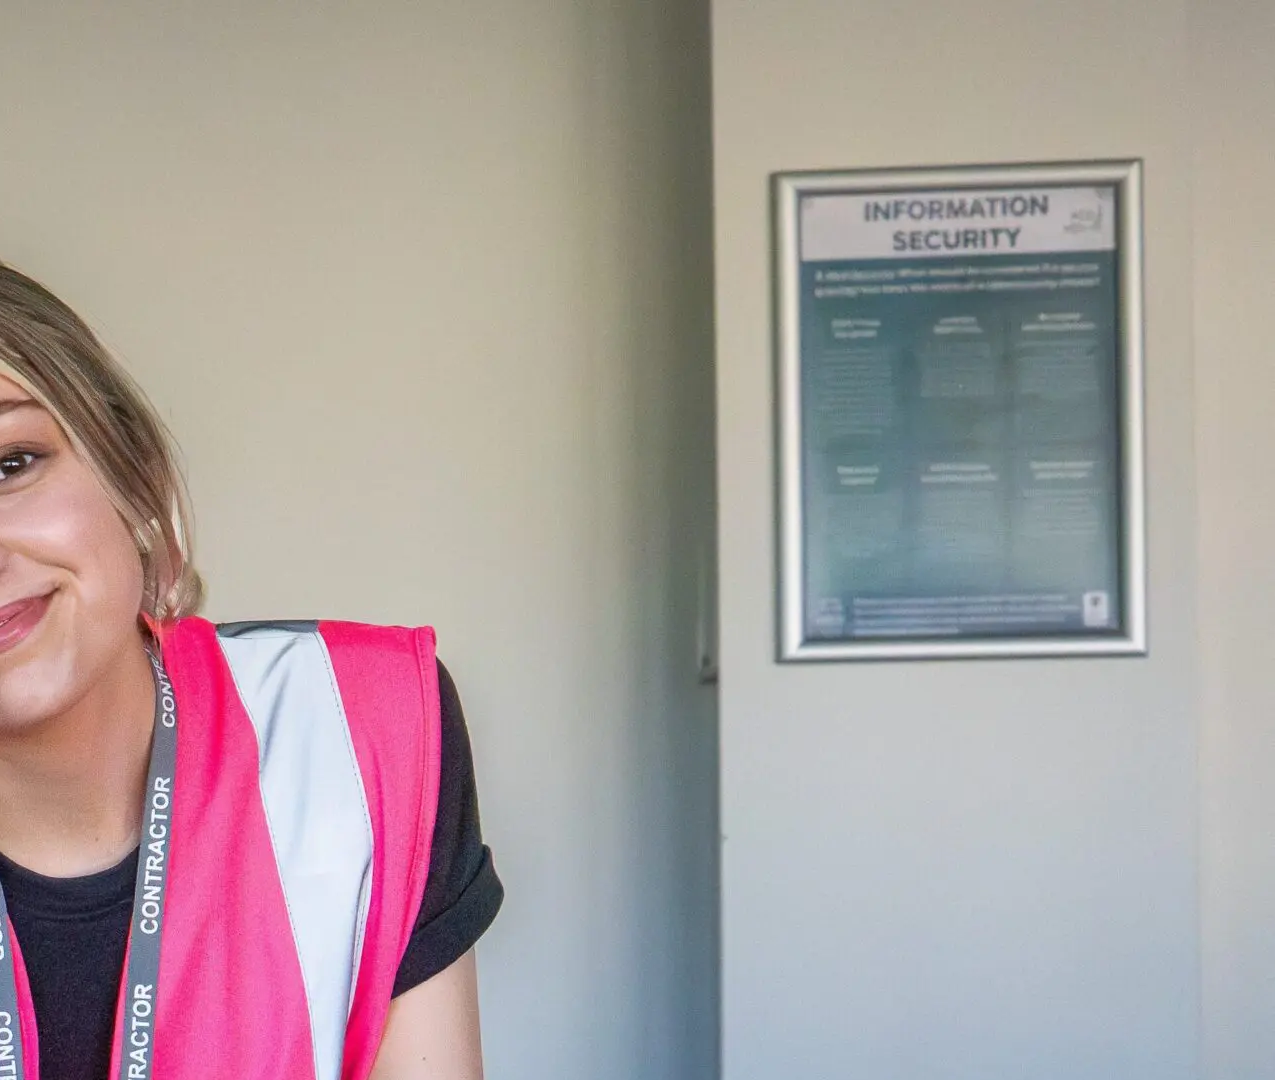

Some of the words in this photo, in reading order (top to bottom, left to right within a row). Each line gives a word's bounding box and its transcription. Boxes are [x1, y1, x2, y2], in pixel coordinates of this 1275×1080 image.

[863, 194, 1049, 222] INFORMATION
[892, 228, 1021, 252] SECURITY
[140, 776, 171, 934] CONTRACTOR
